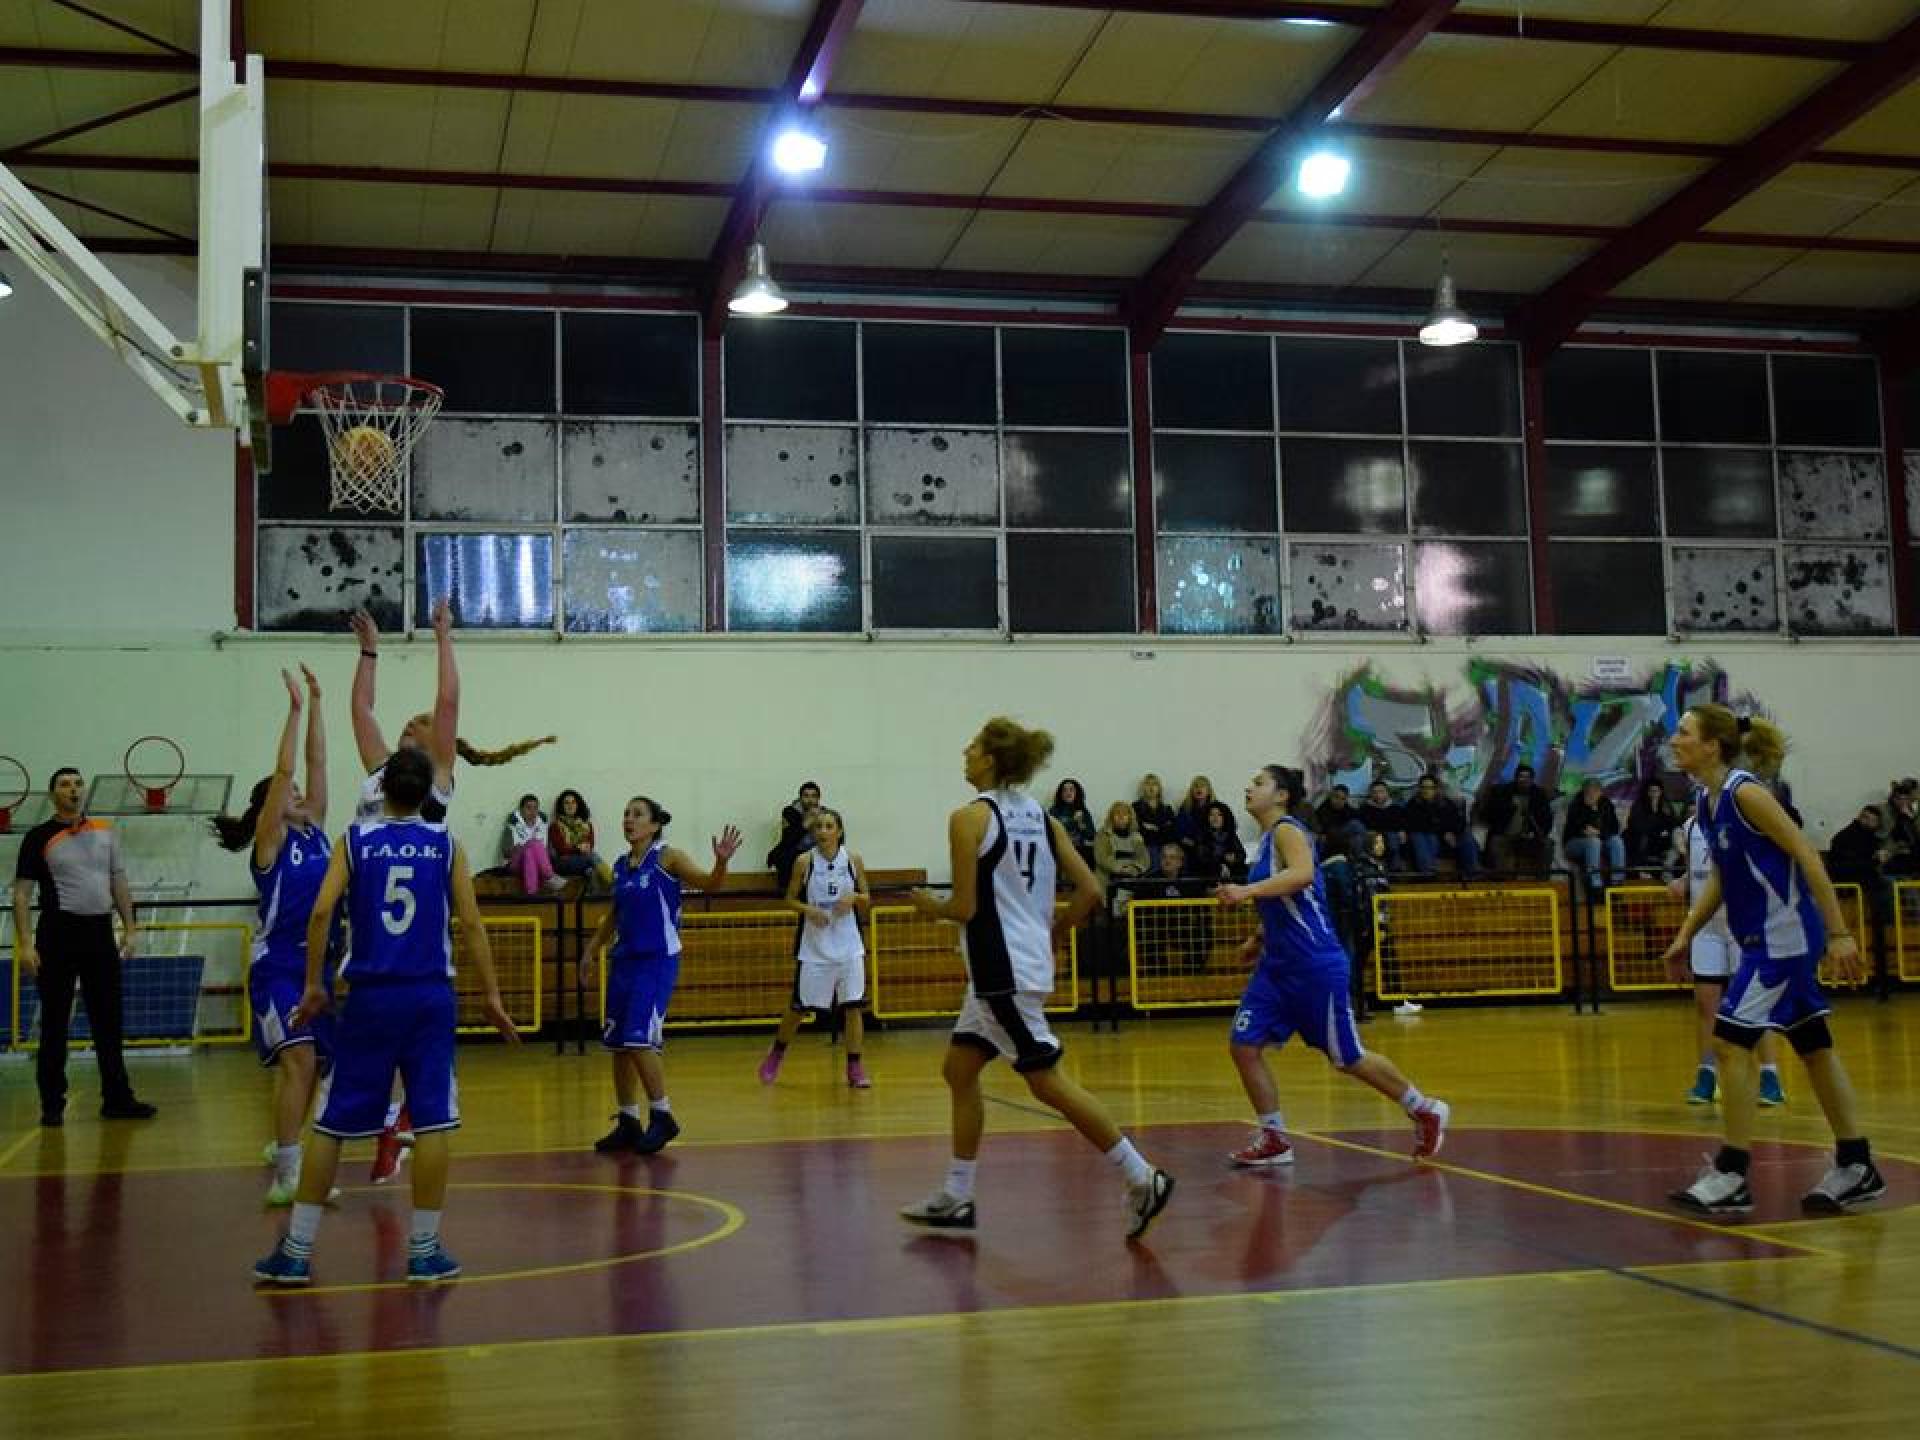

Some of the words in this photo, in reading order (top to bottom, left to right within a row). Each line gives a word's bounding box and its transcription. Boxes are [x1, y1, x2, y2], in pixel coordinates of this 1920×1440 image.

[291, 841, 303, 865] 6
[1013, 840, 1037, 894] 4
[382, 865, 417, 935] 5
